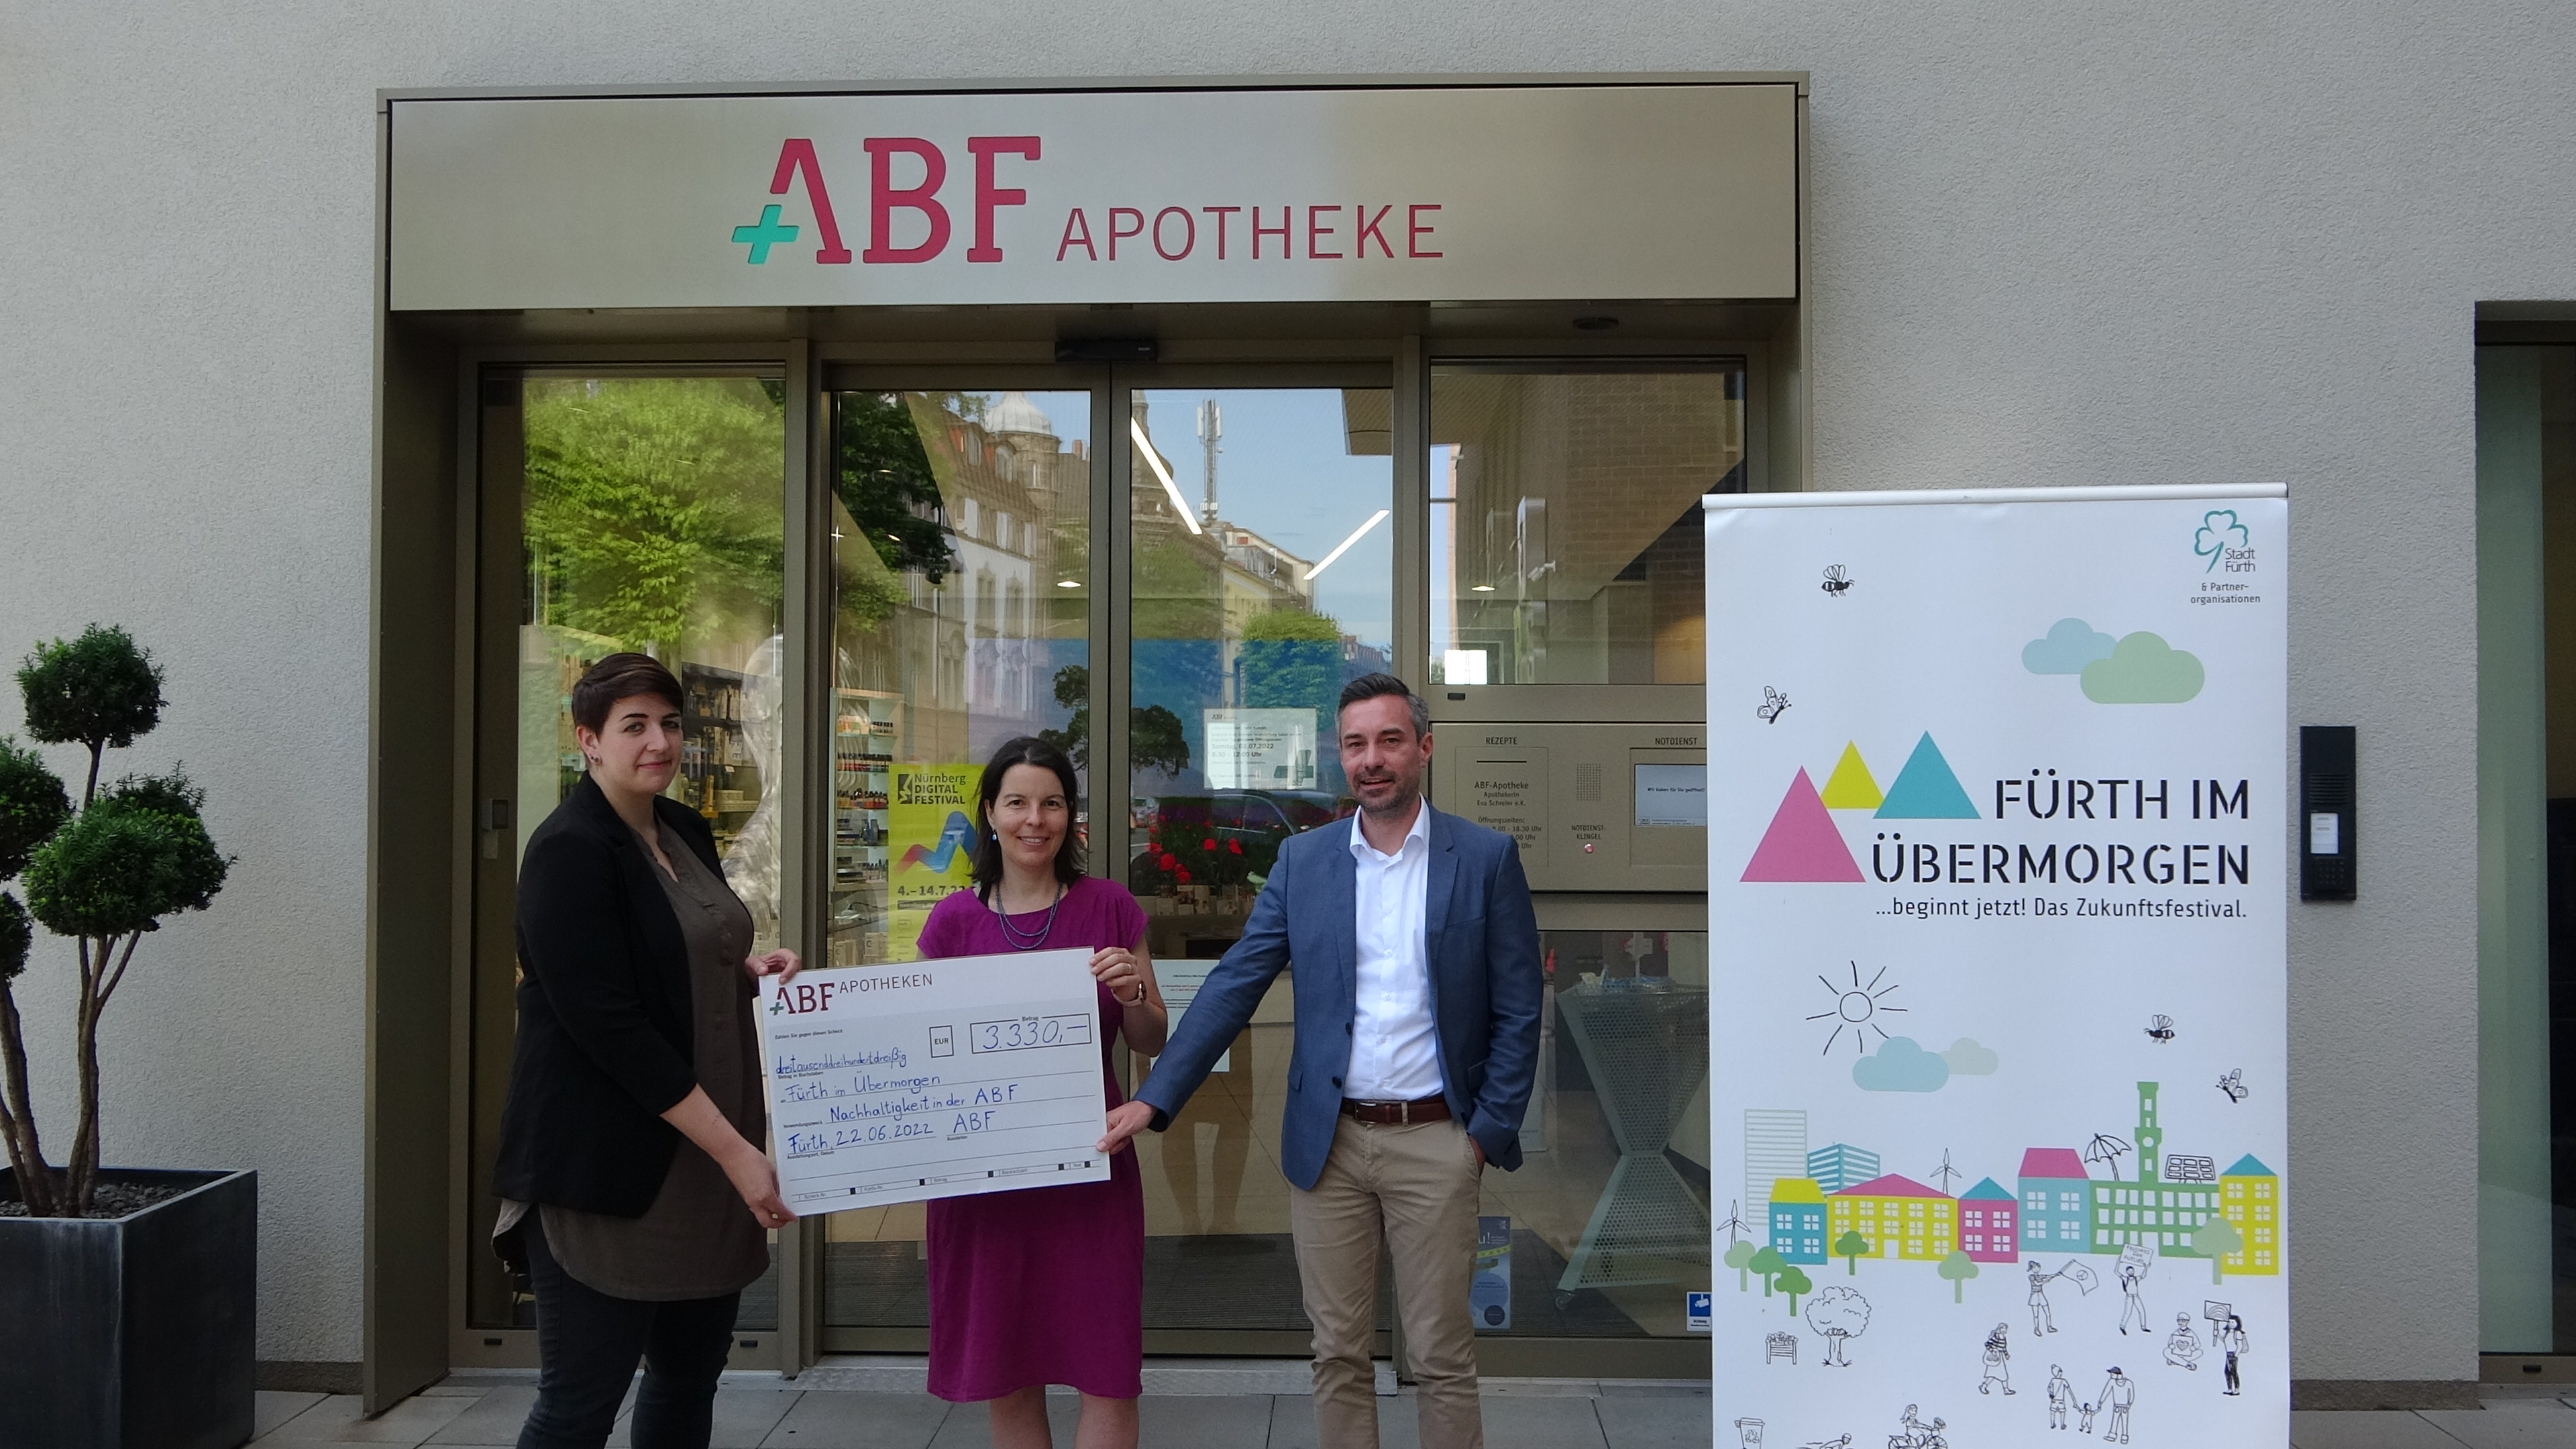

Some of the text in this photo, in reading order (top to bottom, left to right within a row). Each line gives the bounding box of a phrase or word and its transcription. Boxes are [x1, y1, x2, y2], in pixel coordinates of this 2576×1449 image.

[768, 136, 1444, 264] ABF APOTHEKE
[2225, 547, 2255, 559] Stadt
[2225, 561, 2255, 572] Fürth
[2201, 582, 2249, 591] & Partner-
[2190, 594, 2261, 605] organisationen
[1655, 737, 1697, 745] NOTDIENST
[914, 773, 966, 786] Nürnberg
[1474, 782, 1529, 790] ABF-Apotheke
[914, 785, 958, 794] DIGITAL
[1995, 768, 2250, 820] FÜRTH IM
[914, 796, 966, 804] FESTIVAL
[1478, 816, 1525, 824] Öffnungszeiten:
[1872, 833, 2250, 885] ÜBERMORGEN
[1876, 897, 2247, 920] ...beginnt jetzt! Das Zukunftsfestival.
[777, 973, 932, 1014] ABF APOTHEKEN
[785, 1071, 941, 1102] Fürth im Übermorgen
[830, 1083, 1018, 1123] Nachhaltigkeit in der ABF
[953, 1110, 996, 1134] ABF
[836, 1123, 934, 1146] 22.06.2022
